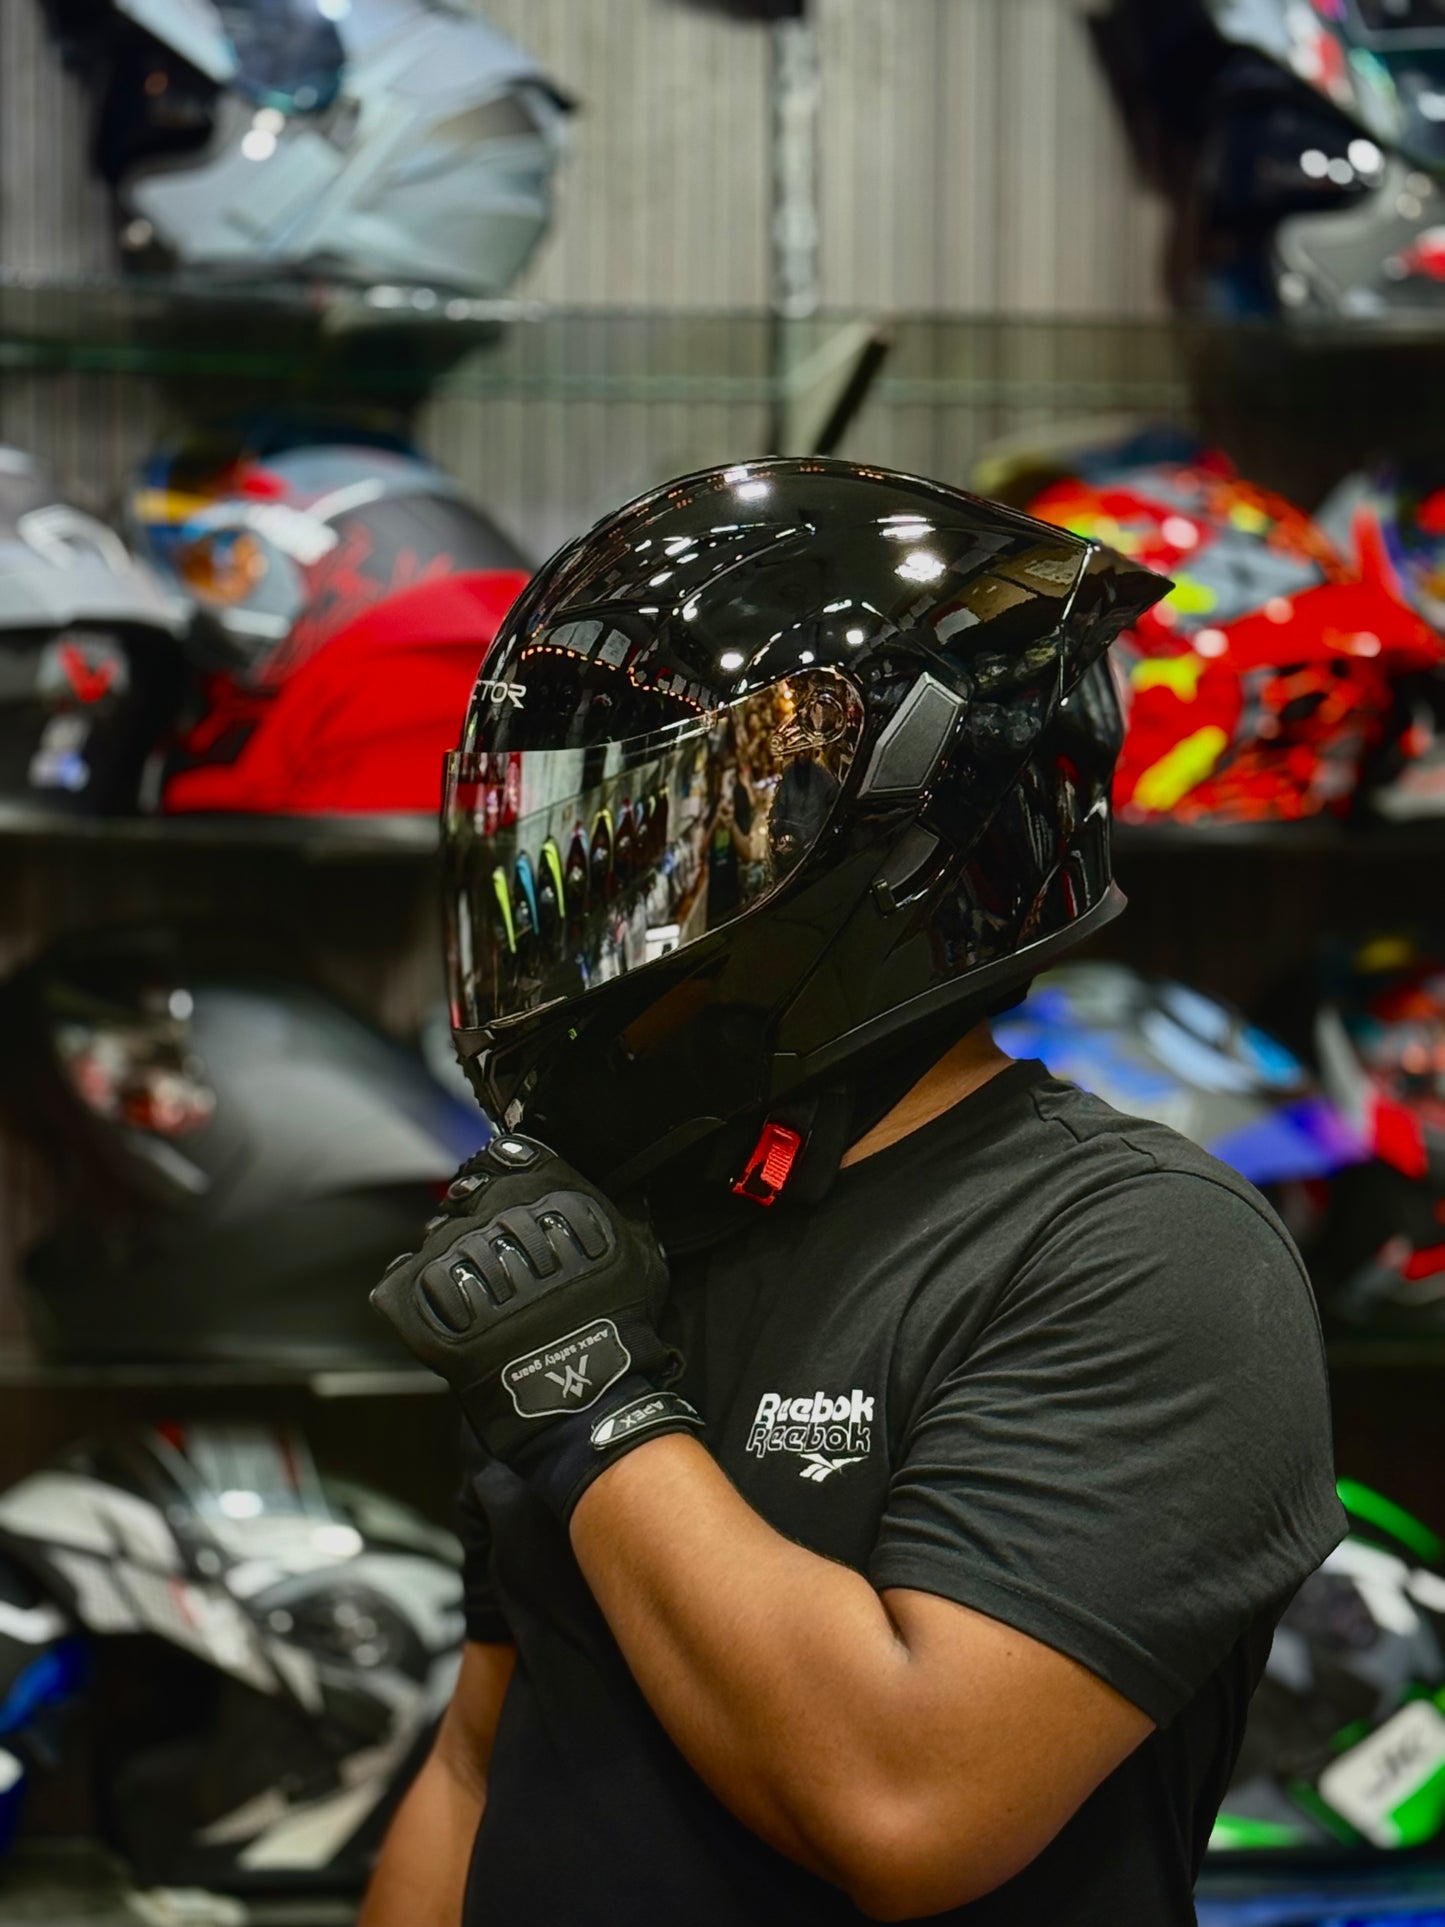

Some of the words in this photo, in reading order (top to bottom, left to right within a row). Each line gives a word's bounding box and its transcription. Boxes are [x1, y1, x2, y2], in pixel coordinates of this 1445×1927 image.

[577, 1328, 608, 1350] APEX
[544, 1344, 578, 1366] safety
[511, 1359, 543, 1382] gears
[620, 1400, 665, 1429] APEX
[753, 1389, 875, 1430] Reebok
[745, 1421, 871, 1458] Reebok
